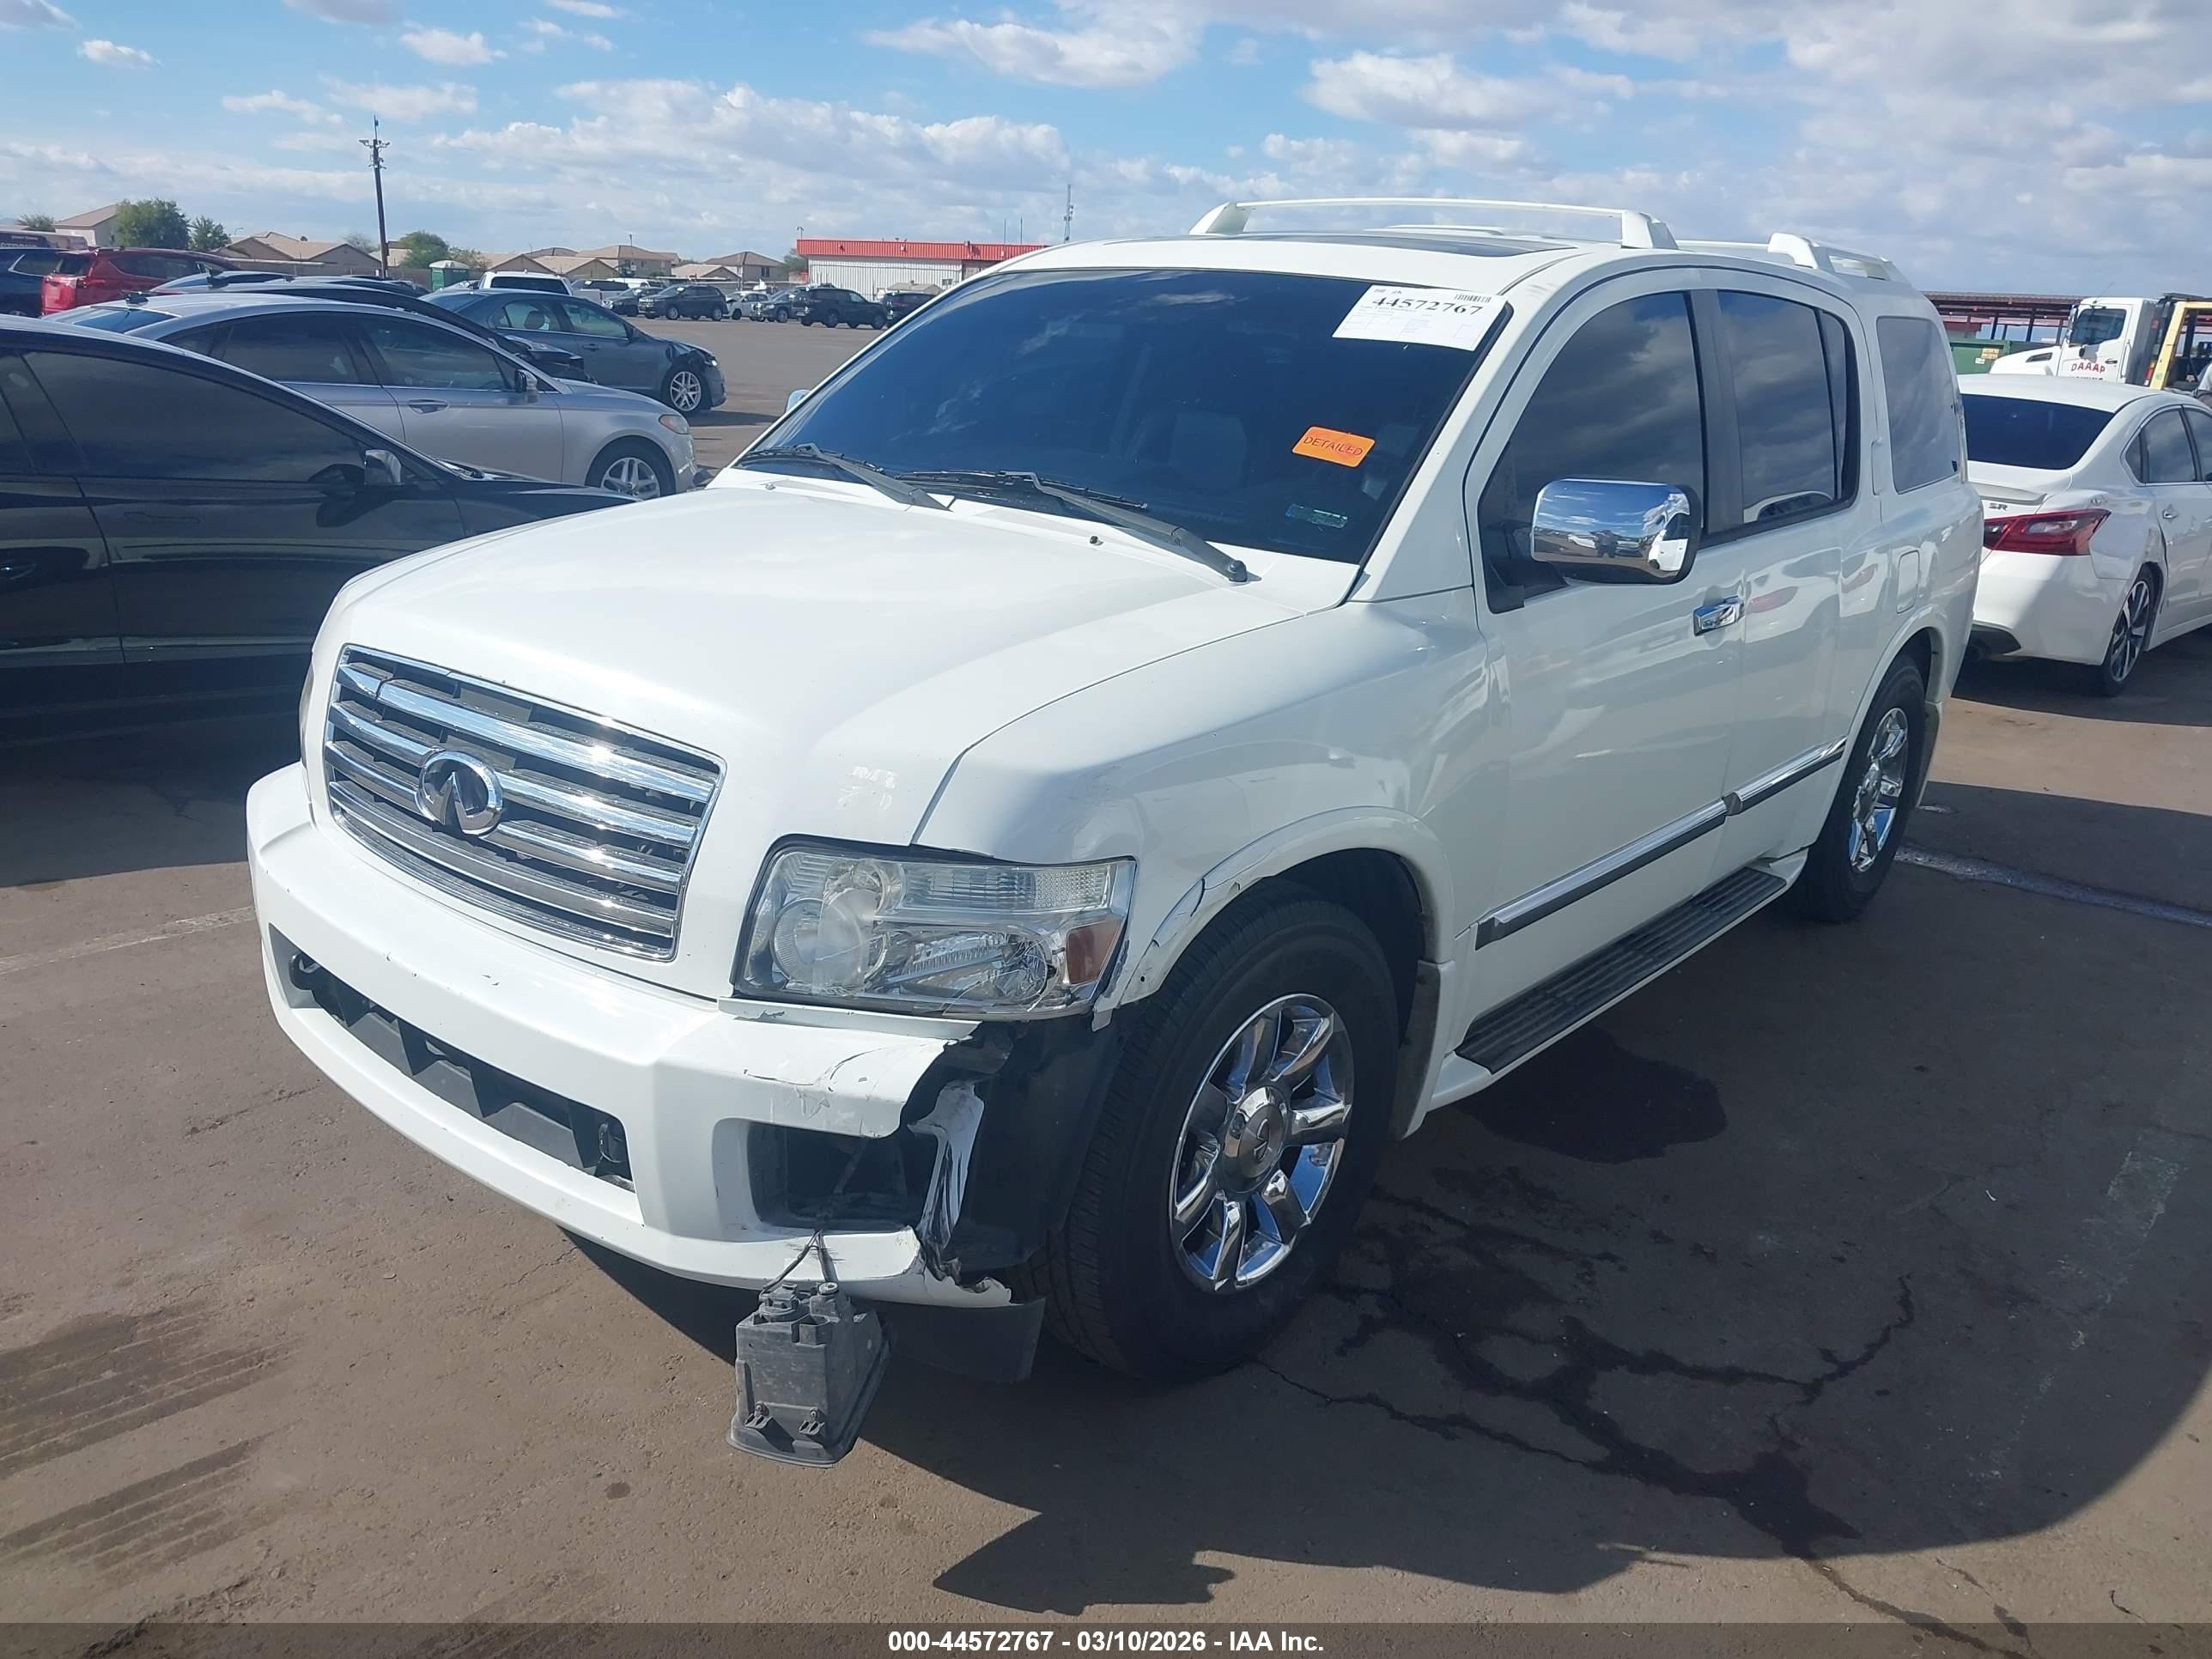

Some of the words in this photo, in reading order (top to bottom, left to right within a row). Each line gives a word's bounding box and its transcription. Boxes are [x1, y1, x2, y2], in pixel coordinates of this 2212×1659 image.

[1372, 296, 1484, 315] 44572767
[1304, 436, 1364, 456] DETAILED
[1988, 502, 2008, 511] SR
